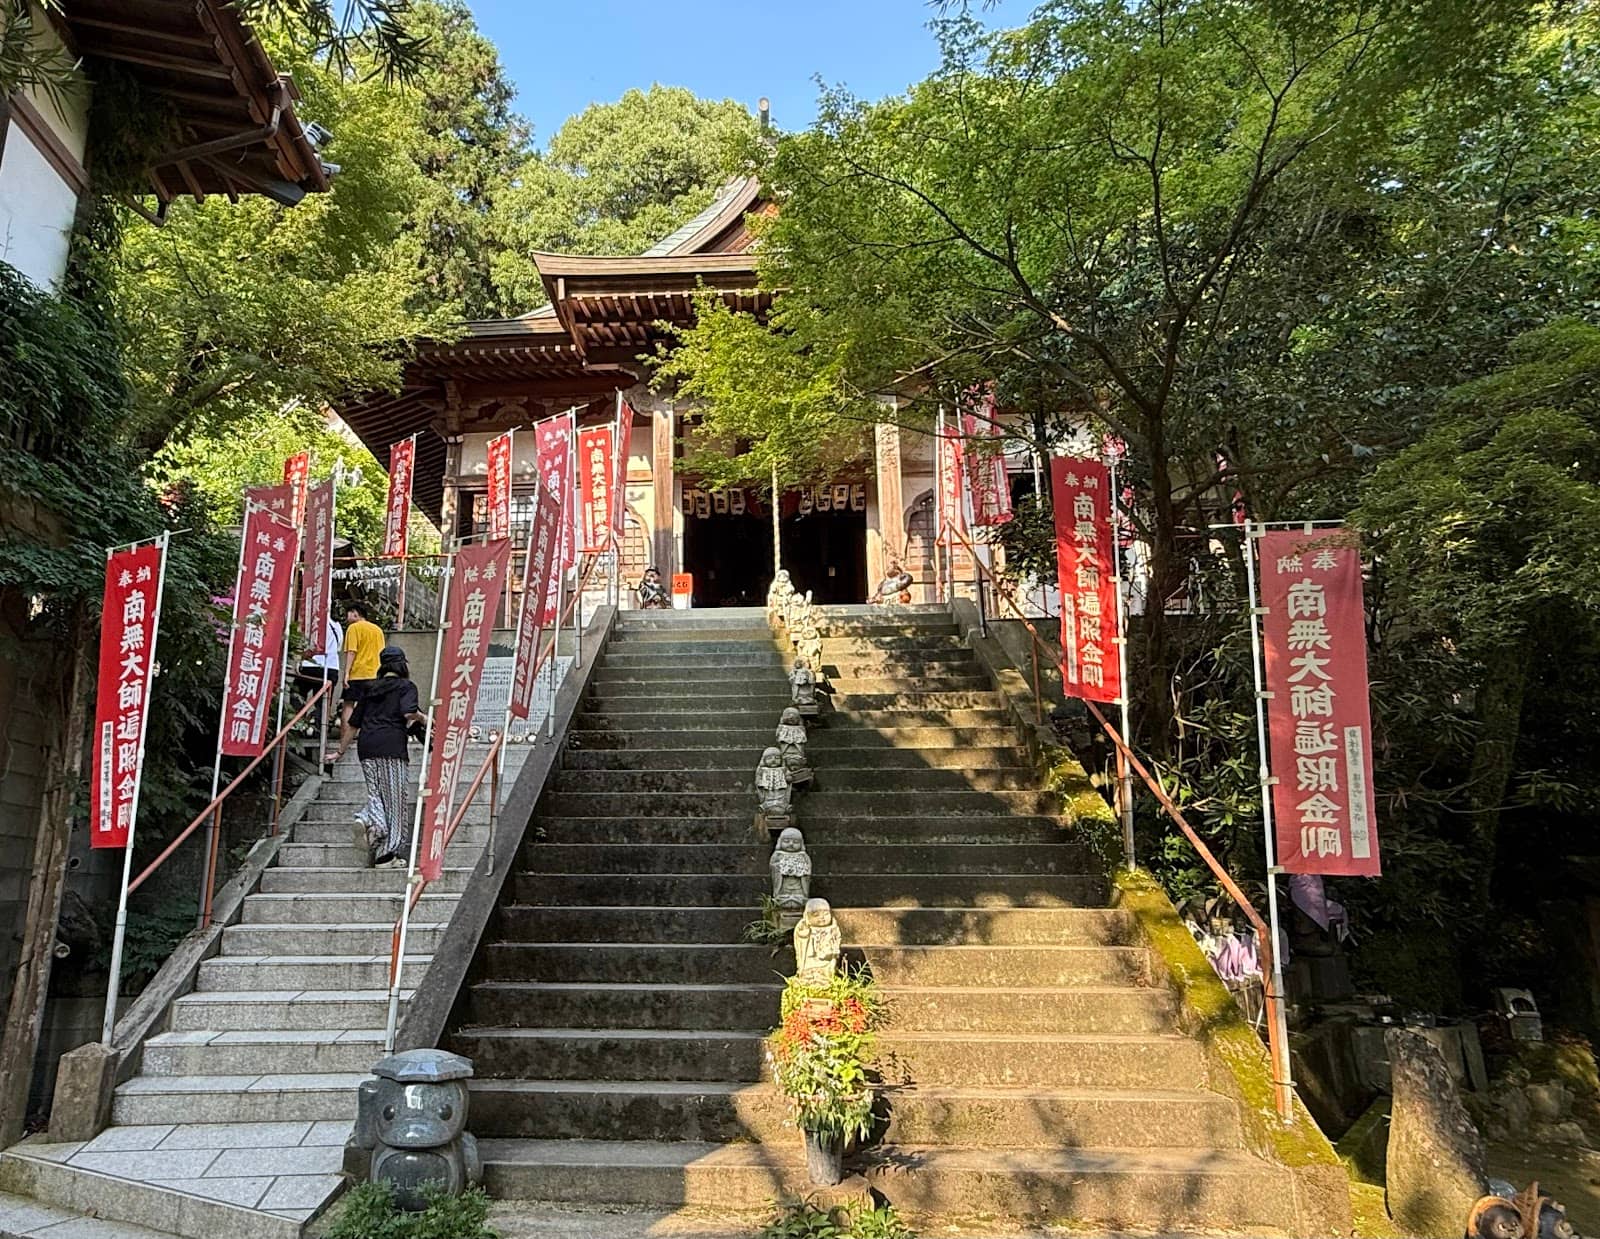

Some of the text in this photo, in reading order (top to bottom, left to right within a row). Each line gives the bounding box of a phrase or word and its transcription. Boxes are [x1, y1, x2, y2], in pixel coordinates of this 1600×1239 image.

[1064, 471, 1098, 489] 奉納
[119, 565, 152, 588] 奉納
[1073, 491, 1105, 688] 南無大師遍照金剛
